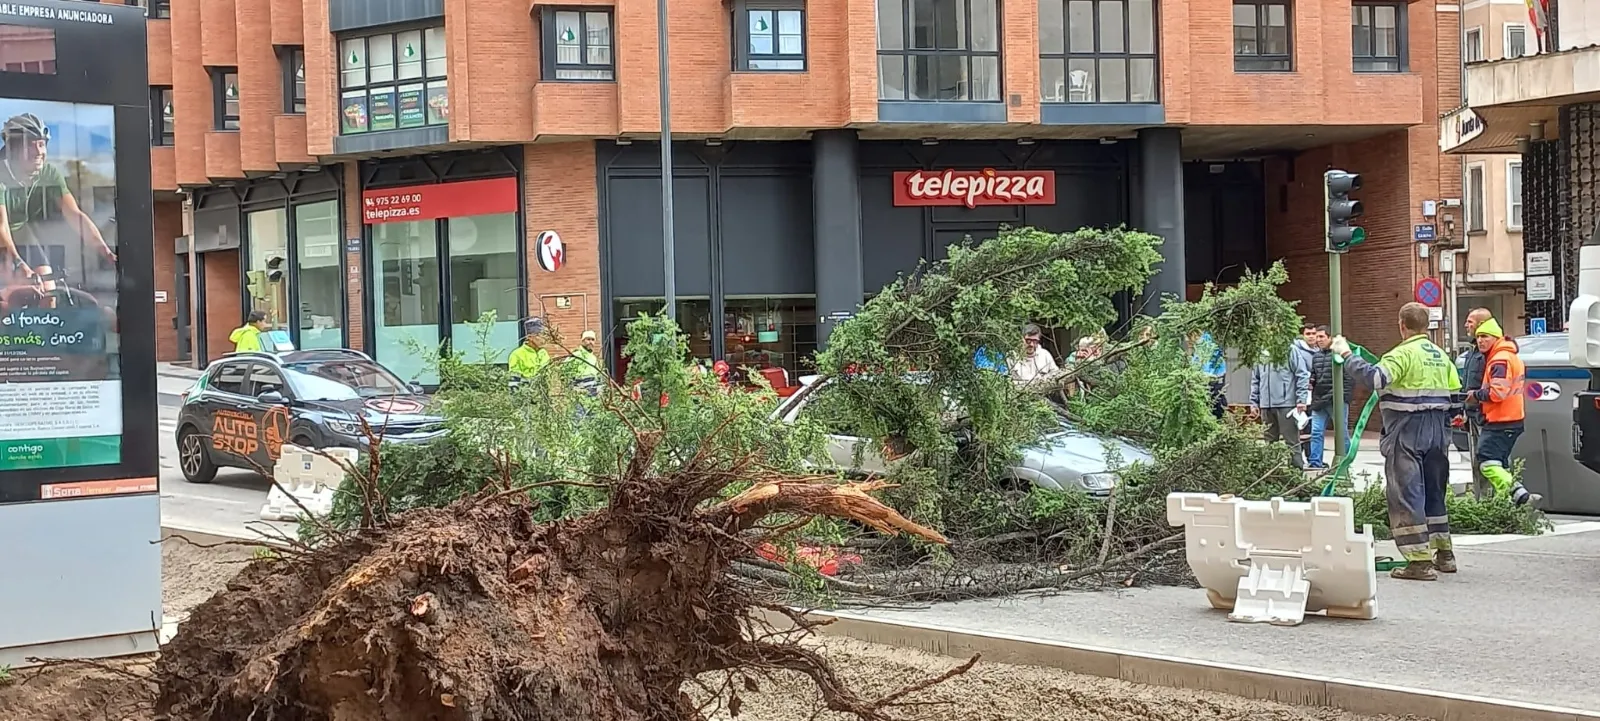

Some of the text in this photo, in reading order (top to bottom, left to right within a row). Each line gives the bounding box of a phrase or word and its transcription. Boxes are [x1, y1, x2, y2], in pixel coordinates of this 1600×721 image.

[19, 5, 55, 19] EMPRESA
[57, 9, 114, 24] ANUNCIADORA
[909, 168, 1045, 206] telepizza
[375, 193, 422, 206] 975 22 69 00
[366, 206, 421, 221] telepizza.es
[2, 311, 65, 328] el fondo,
[14, 331, 46, 346] más,
[50, 331, 84, 346] ¿no?
[213, 416, 257, 439] AUTO
[8, 444, 43, 454] contigo
[213, 433, 259, 455] STOP
